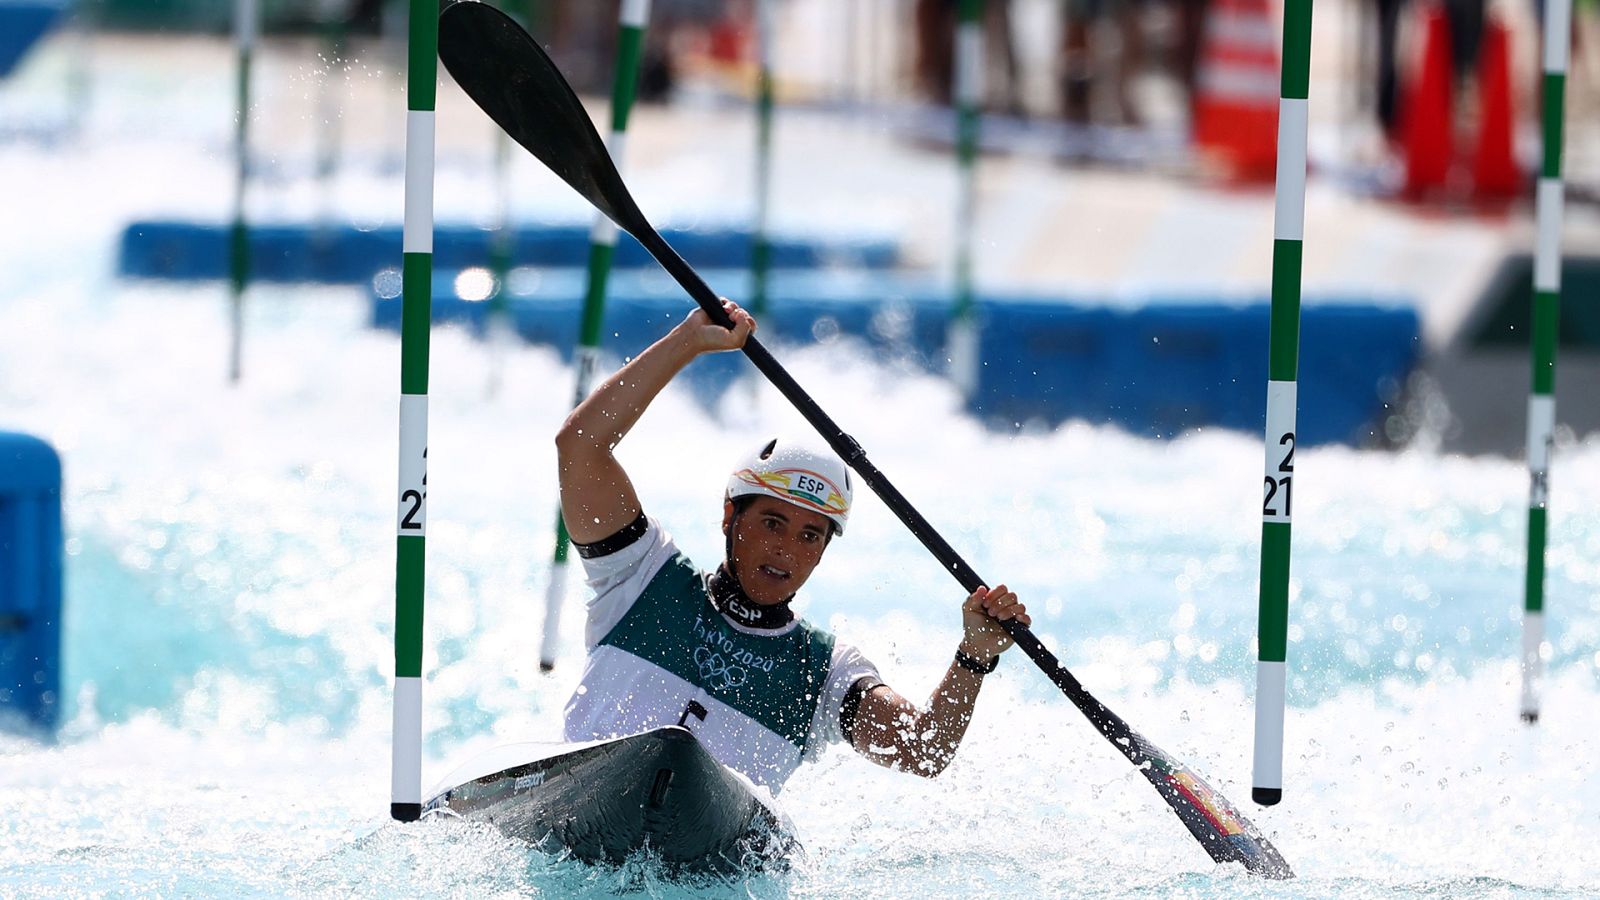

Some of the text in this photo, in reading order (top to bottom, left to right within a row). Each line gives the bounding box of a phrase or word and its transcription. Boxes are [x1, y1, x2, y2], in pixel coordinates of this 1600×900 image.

[1279, 432, 1295, 472] 2
[797, 475, 825, 494] ESP
[1263, 475, 1291, 516] 21
[401, 489, 427, 529] 2
[732, 647, 774, 672] 2020
